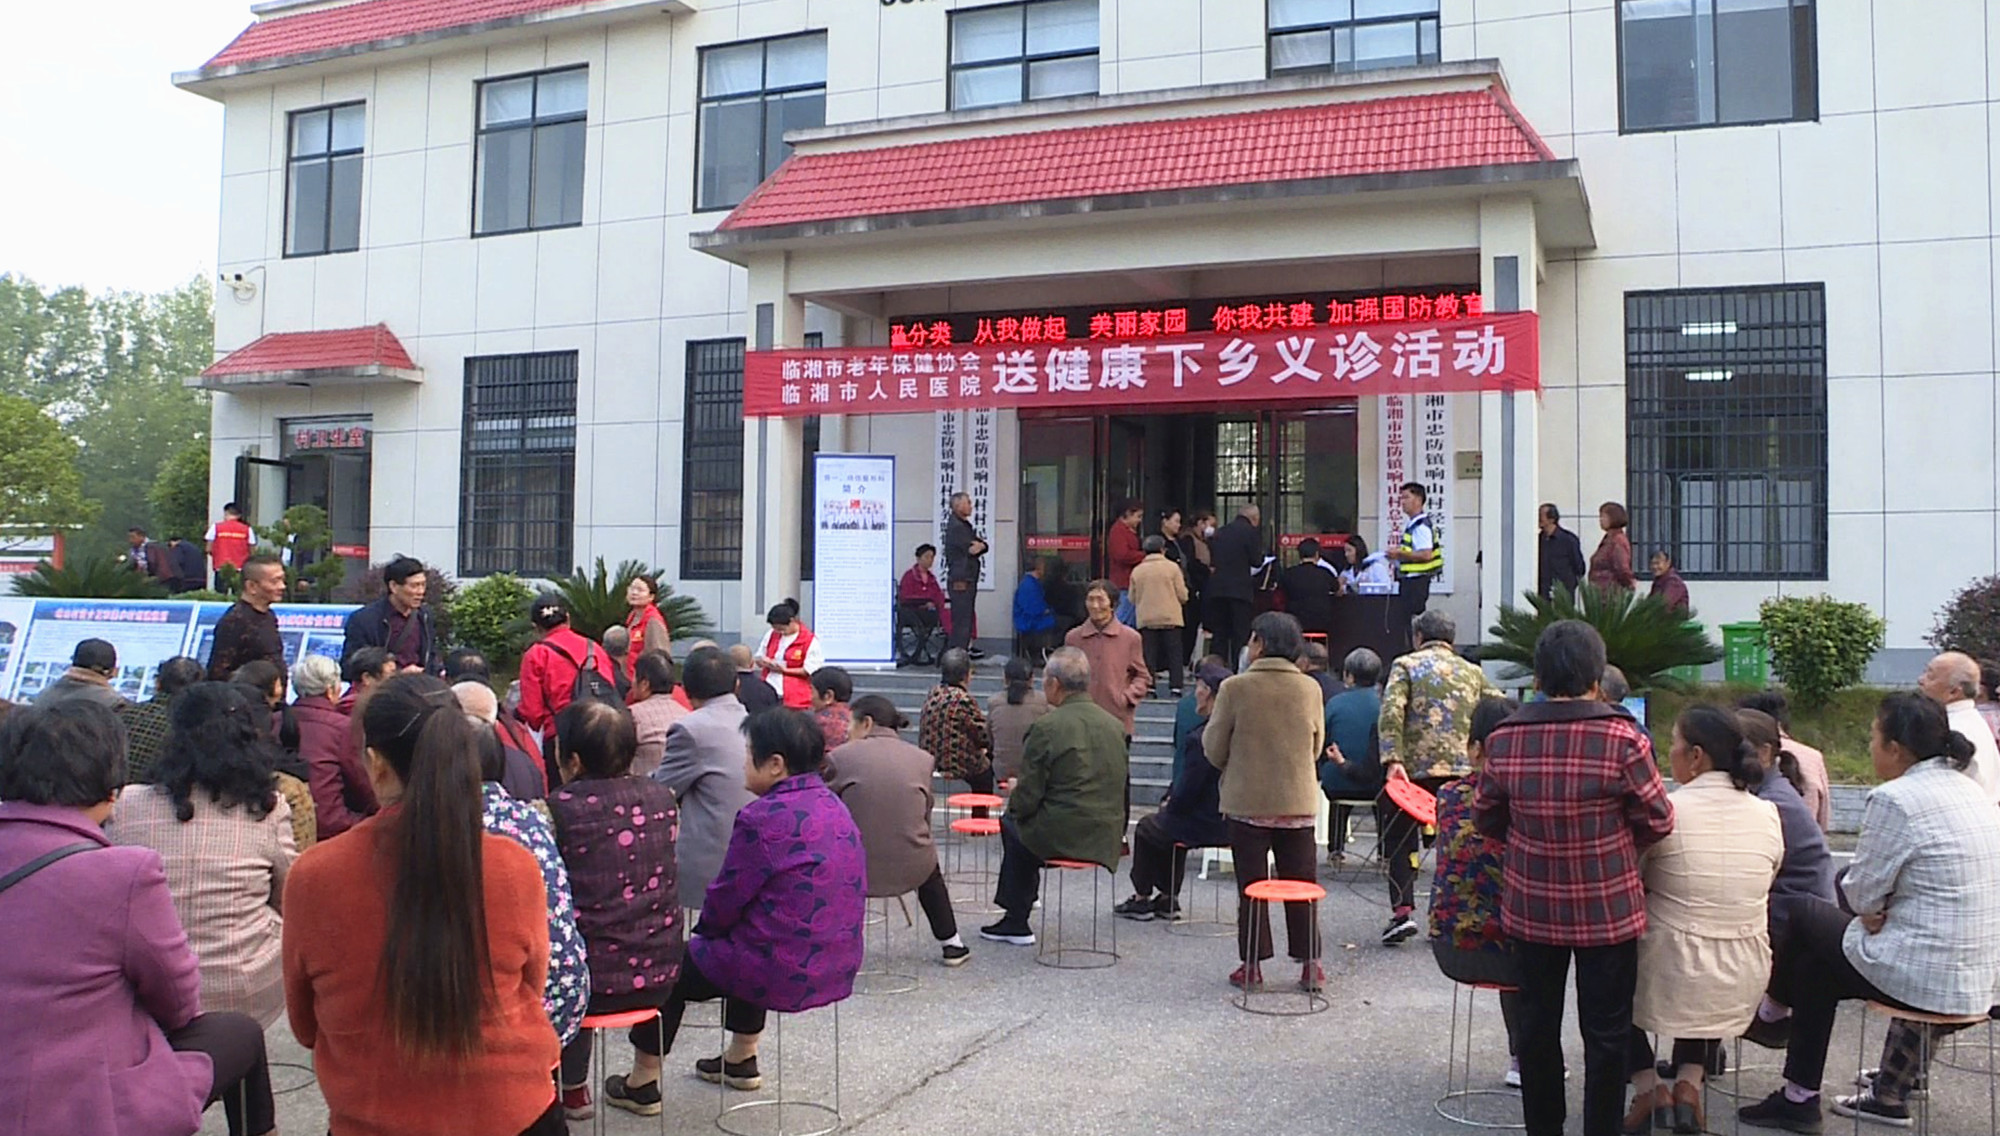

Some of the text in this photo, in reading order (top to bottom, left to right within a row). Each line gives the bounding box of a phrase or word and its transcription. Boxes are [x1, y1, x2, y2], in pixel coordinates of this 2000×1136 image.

[975, 315, 1067, 345] 从我做起
[1090, 308, 1187, 338] 美丽家园
[1213, 301, 1316, 331] 你我共建
[1328, 293, 1484, 327] 加强国防教育
[781, 350, 982, 381] 临湘市老年保健协会
[991, 325, 1507, 395] 送健康下乡义诊活动
[781, 375, 982, 405] 临湘市人民医院
